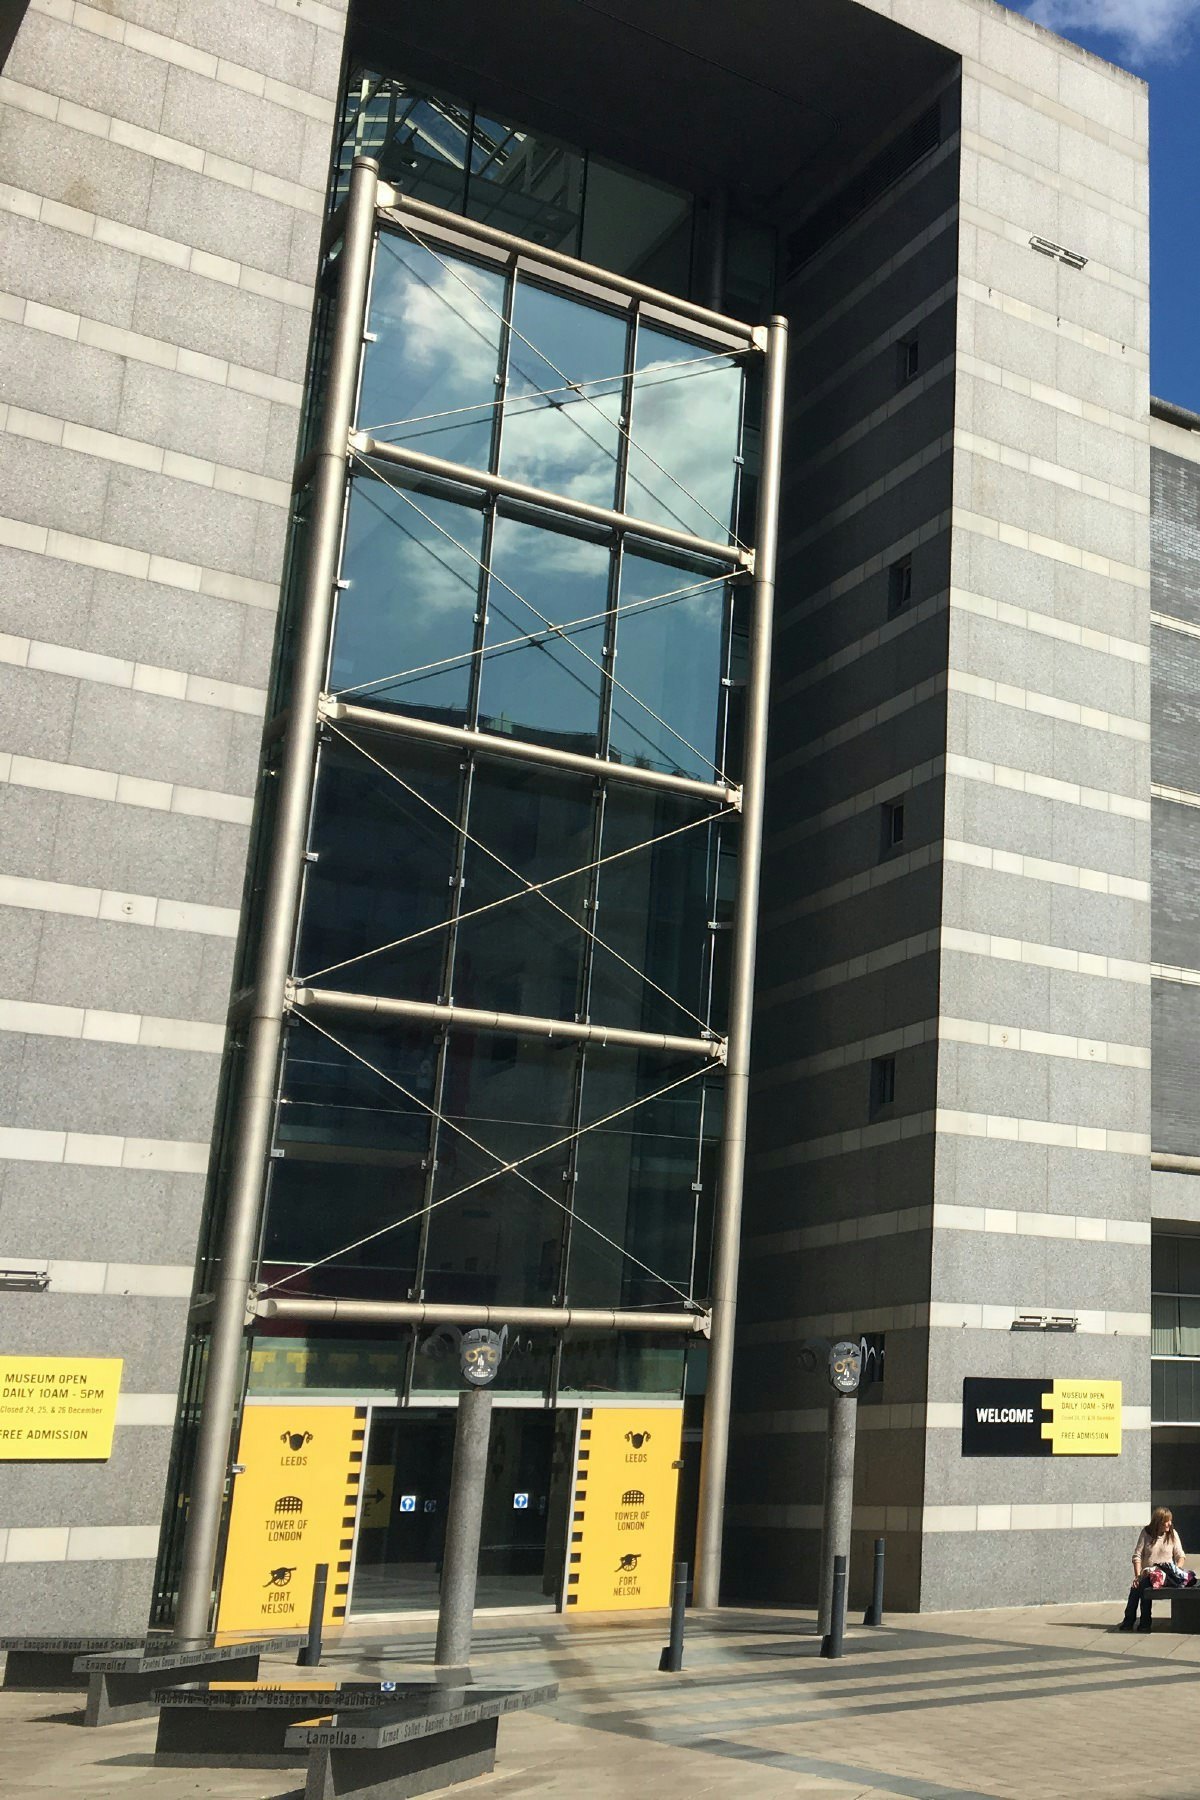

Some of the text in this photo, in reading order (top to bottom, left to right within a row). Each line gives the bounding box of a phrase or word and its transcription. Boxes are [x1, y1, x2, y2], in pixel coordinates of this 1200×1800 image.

[4, 1373, 88, 1385] MUSEUM OPEN
[2, 1387, 34, 1398] DAILY
[39, 1388, 69, 1399] 10AM
[79, 1389, 105, 1399] 5PM
[1061, 1391, 1105, 1400] MUSEUM OPEN
[0, 1405, 24, 1414] Closed
[50, 1406, 56, 1414] &
[57, 1406, 66, 1414] 26
[68, 1406, 103, 1414] December
[1061, 1402, 1078, 1410] DAILY
[1080, 1402, 1096, 1410] 10AM
[975, 1408, 1034, 1423] WELCOME
[26, 1430, 88, 1440] ADMISSION
[1061, 1431, 1109, 1440] FREE ADMISSION
[280, 1456, 308, 1467] LEEDS
[625, 1453, 648, 1463] LEEDS
[614, 1510, 650, 1521] TOWER OF
[265, 1519, 309, 1530] TOWER OF
[617, 1521, 645, 1531] LONDON
[268, 1531, 302, 1542] LONDON
[618, 1576, 637, 1586] FORT
[268, 1591, 291, 1602] FORT
[613, 1587, 641, 1597] NELSON
[261, 1603, 295, 1614] NELSON
[85, 1659, 126, 1671] Enamelled
[306, 1730, 357, 1745] Lamellae
